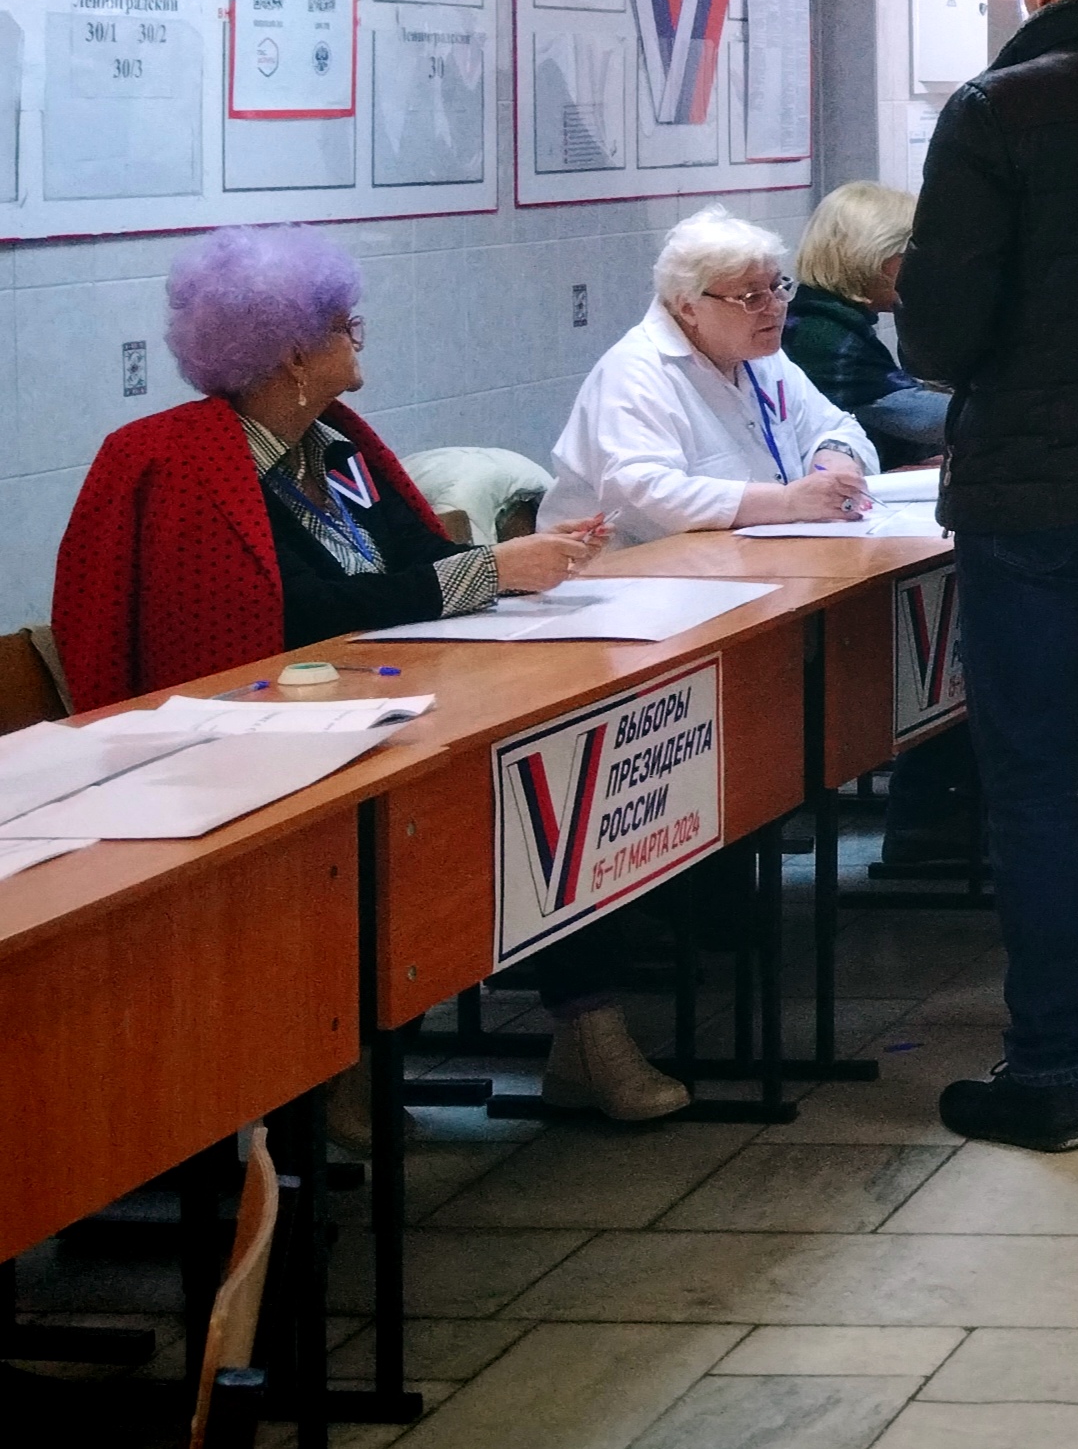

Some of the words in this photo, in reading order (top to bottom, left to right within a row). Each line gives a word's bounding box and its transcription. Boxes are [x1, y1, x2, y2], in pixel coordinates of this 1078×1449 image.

[85, 22, 117, 43] 30/1
[137, 23, 167, 43] 30/2
[112, 58, 143, 79] 30/3
[613, 686, 692, 750] ВЫБОРЫ
[605, 719, 713, 800] ПРЕЗИДЕНТА
[596, 783, 670, 850] РОССИИ
[627, 825, 669, 874] МАРТА
[671, 810, 701, 851] 2024
